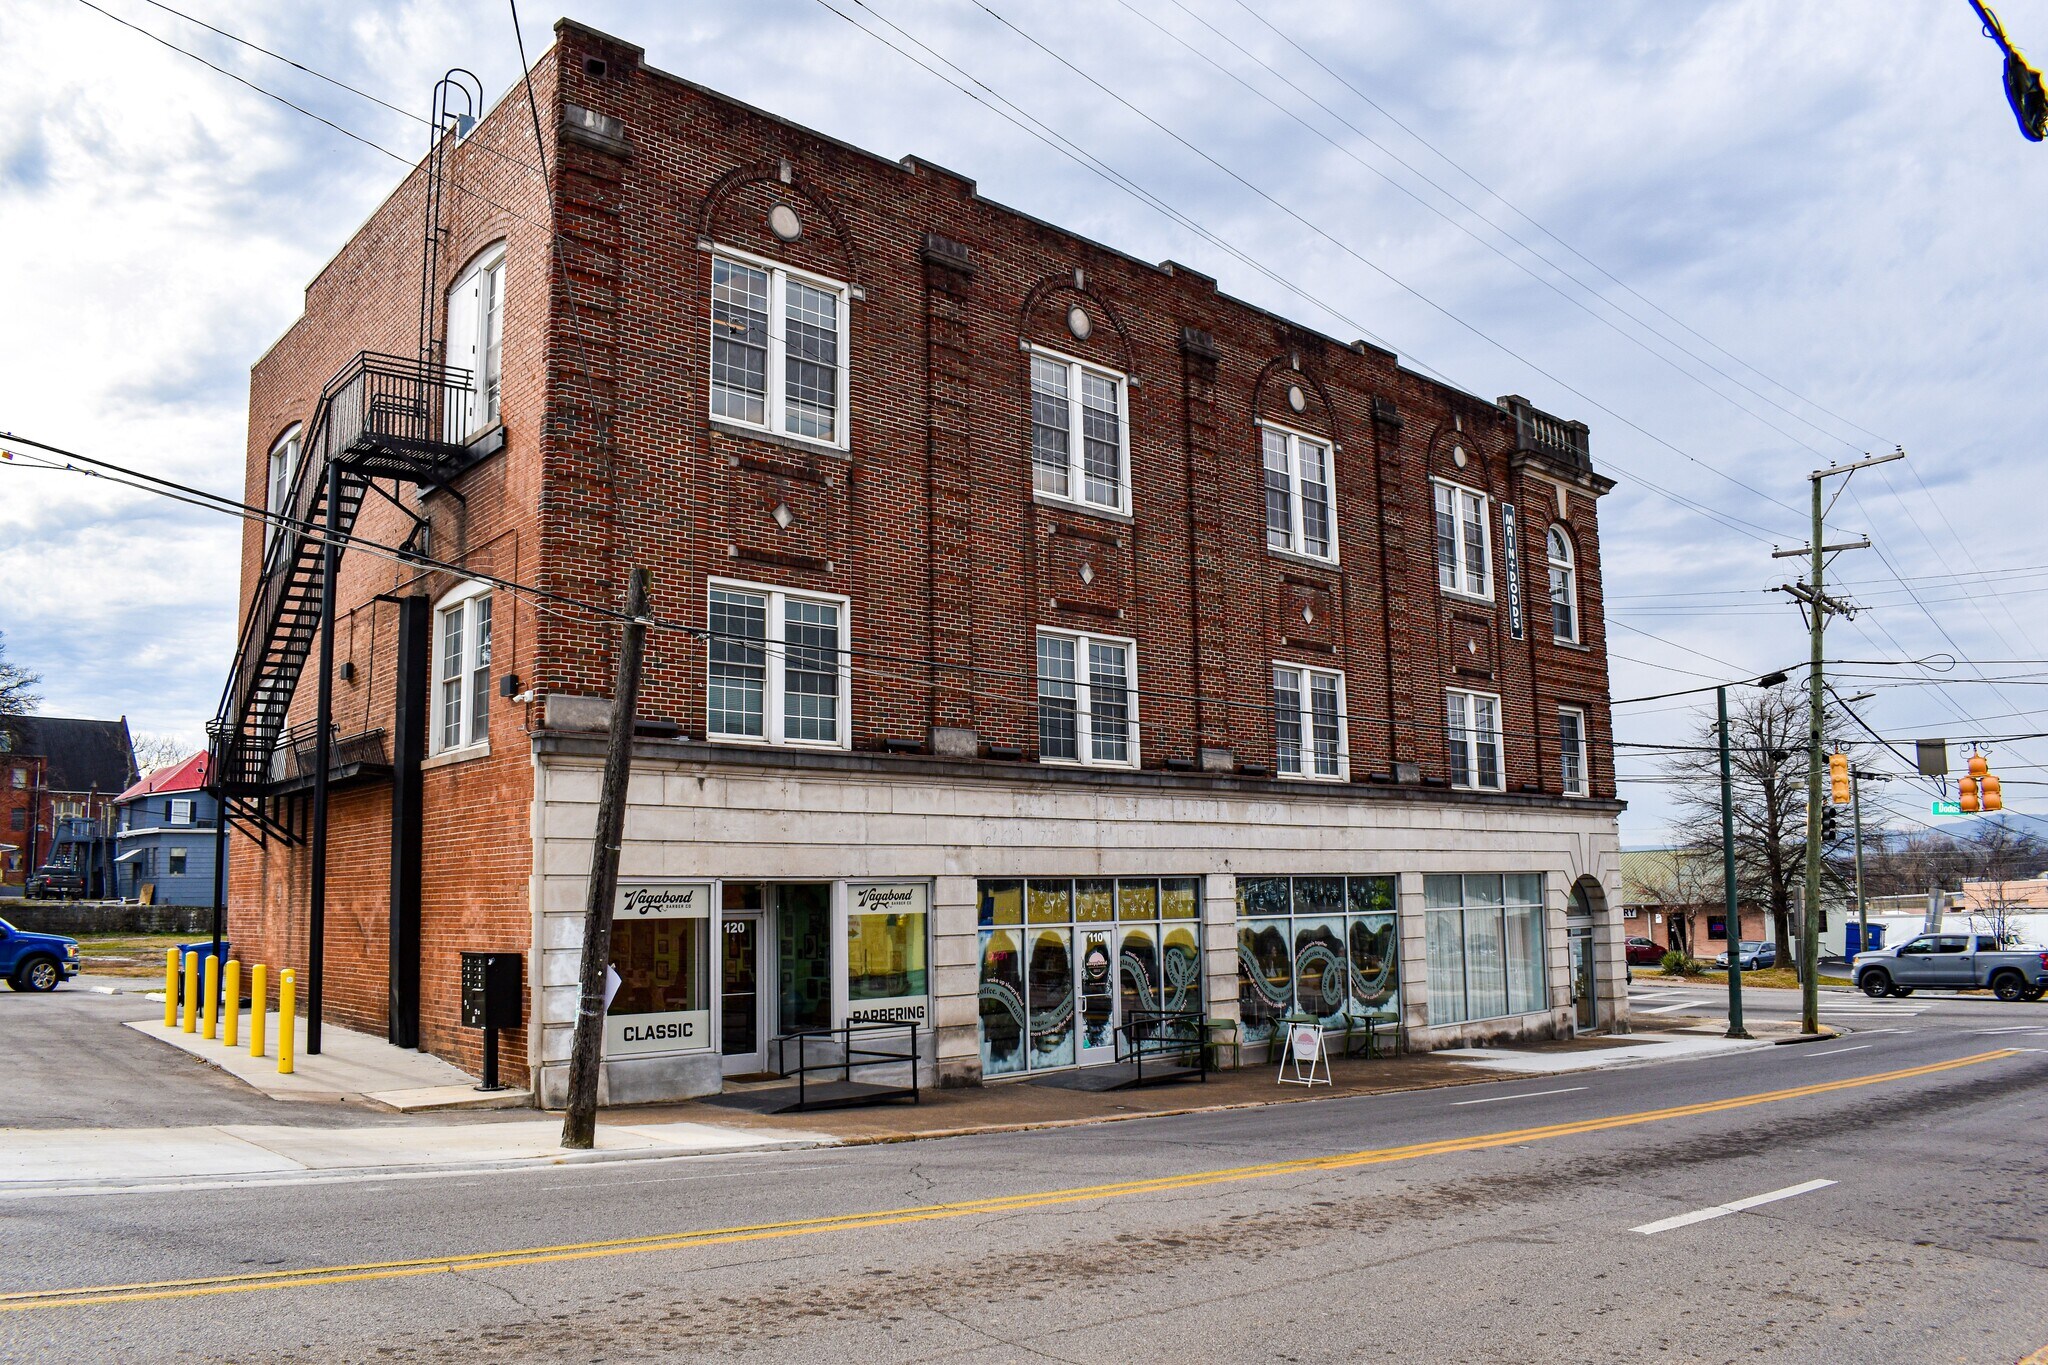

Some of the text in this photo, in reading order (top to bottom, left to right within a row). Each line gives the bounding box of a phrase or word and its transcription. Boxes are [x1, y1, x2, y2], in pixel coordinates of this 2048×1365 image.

[624, 889, 694, 915] Vagabond
[858, 888, 914, 911] Vagabond
[724, 922, 745, 934] 120
[1089, 932, 1103, 943] 110
[979, 986, 998, 995] offee,
[853, 1005, 925, 1024] BARBERING
[624, 1022, 693, 1042] CLASSIC
